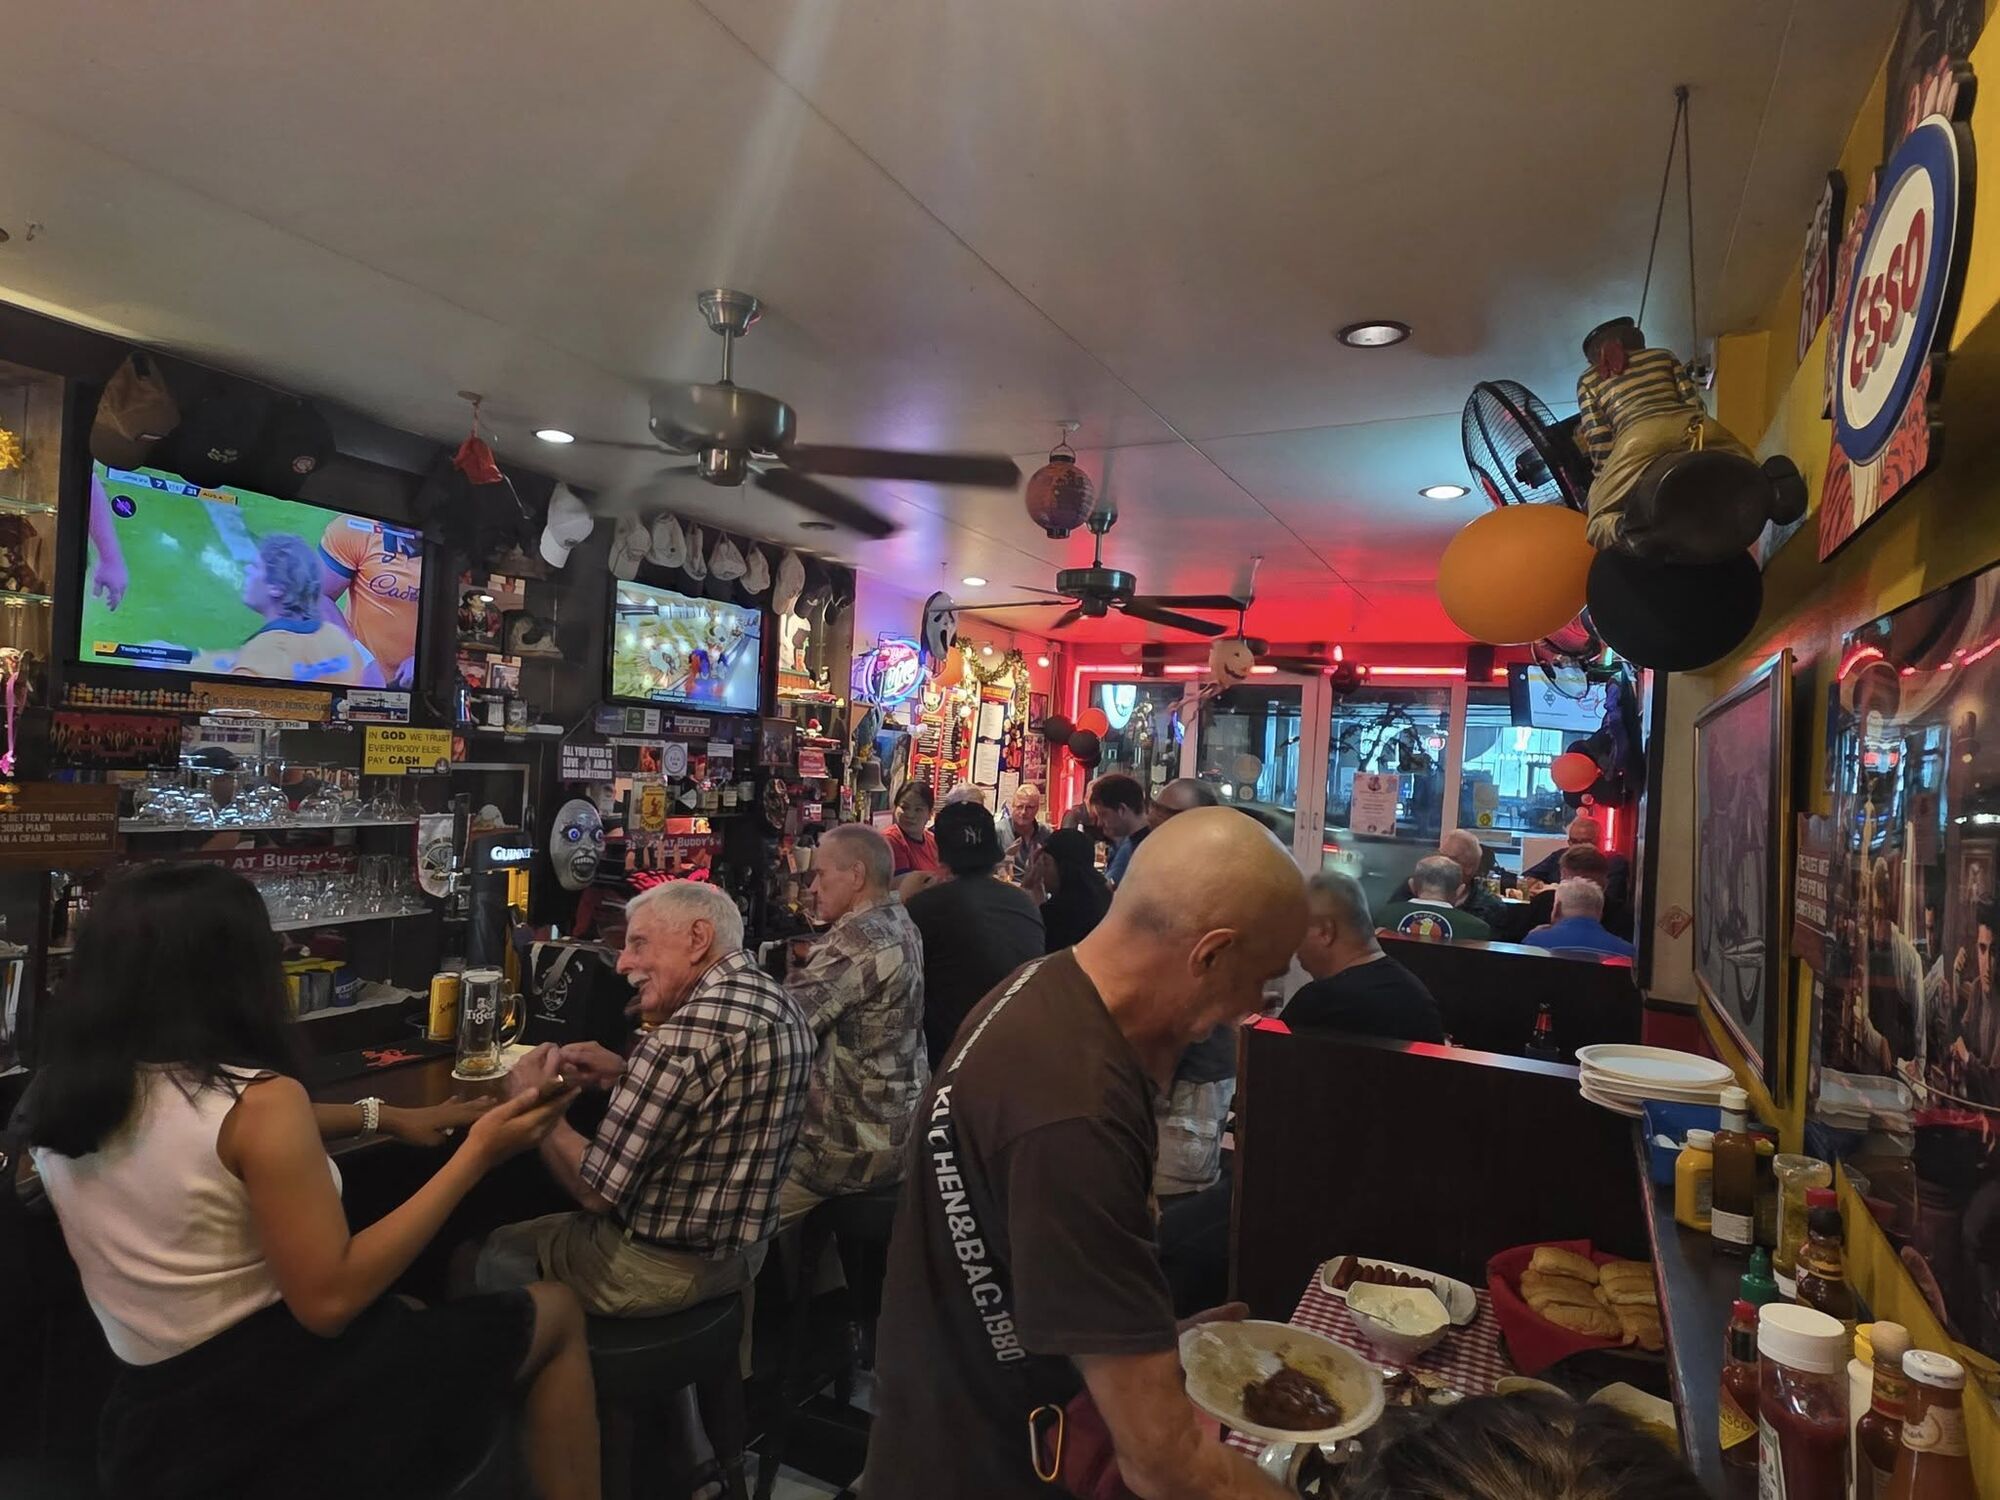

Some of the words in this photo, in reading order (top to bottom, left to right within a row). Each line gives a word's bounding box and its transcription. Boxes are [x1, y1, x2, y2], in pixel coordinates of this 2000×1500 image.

[1850, 208, 1925, 389] ESSO
[678, 726, 705, 734] TEXAS
[368, 731, 378, 739] IN
[382, 730, 406, 740] GOD
[425, 734, 450, 742] TRUST
[368, 744, 420, 754] EVERYBODY
[422, 746, 442, 754] ELSE
[389, 756, 420, 765] CASH
[55, 814, 75, 822] HAVE
[26, 823, 51, 832] PIANO
[232, 856, 257, 869] AT
[466, 1008, 497, 1025] Tiger
